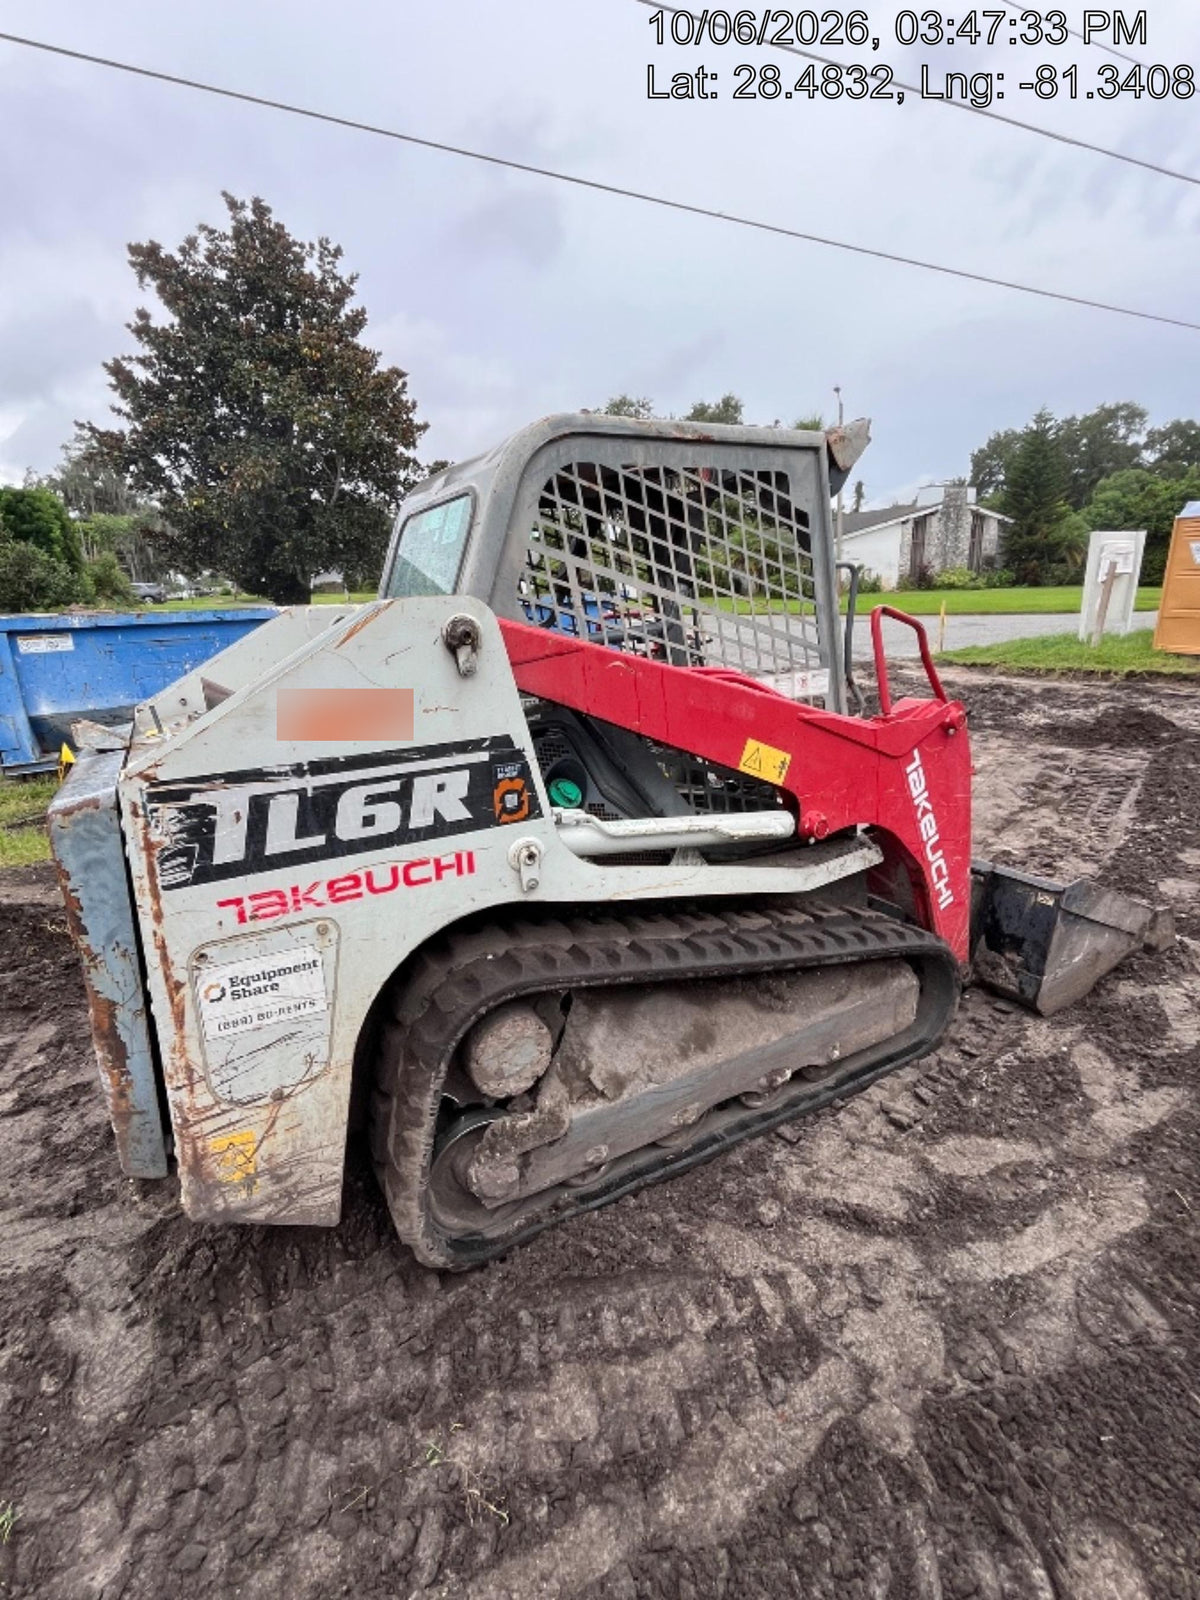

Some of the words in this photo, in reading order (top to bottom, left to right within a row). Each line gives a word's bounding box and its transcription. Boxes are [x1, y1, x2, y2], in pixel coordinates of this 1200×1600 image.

[190, 769, 474, 866] TL6R
[905, 748, 954, 910] TAKEUCHI
[217, 851, 476, 924] TAKEUCHI
[228, 958, 319, 989] Equipment
[230, 982, 280, 1001] Share
